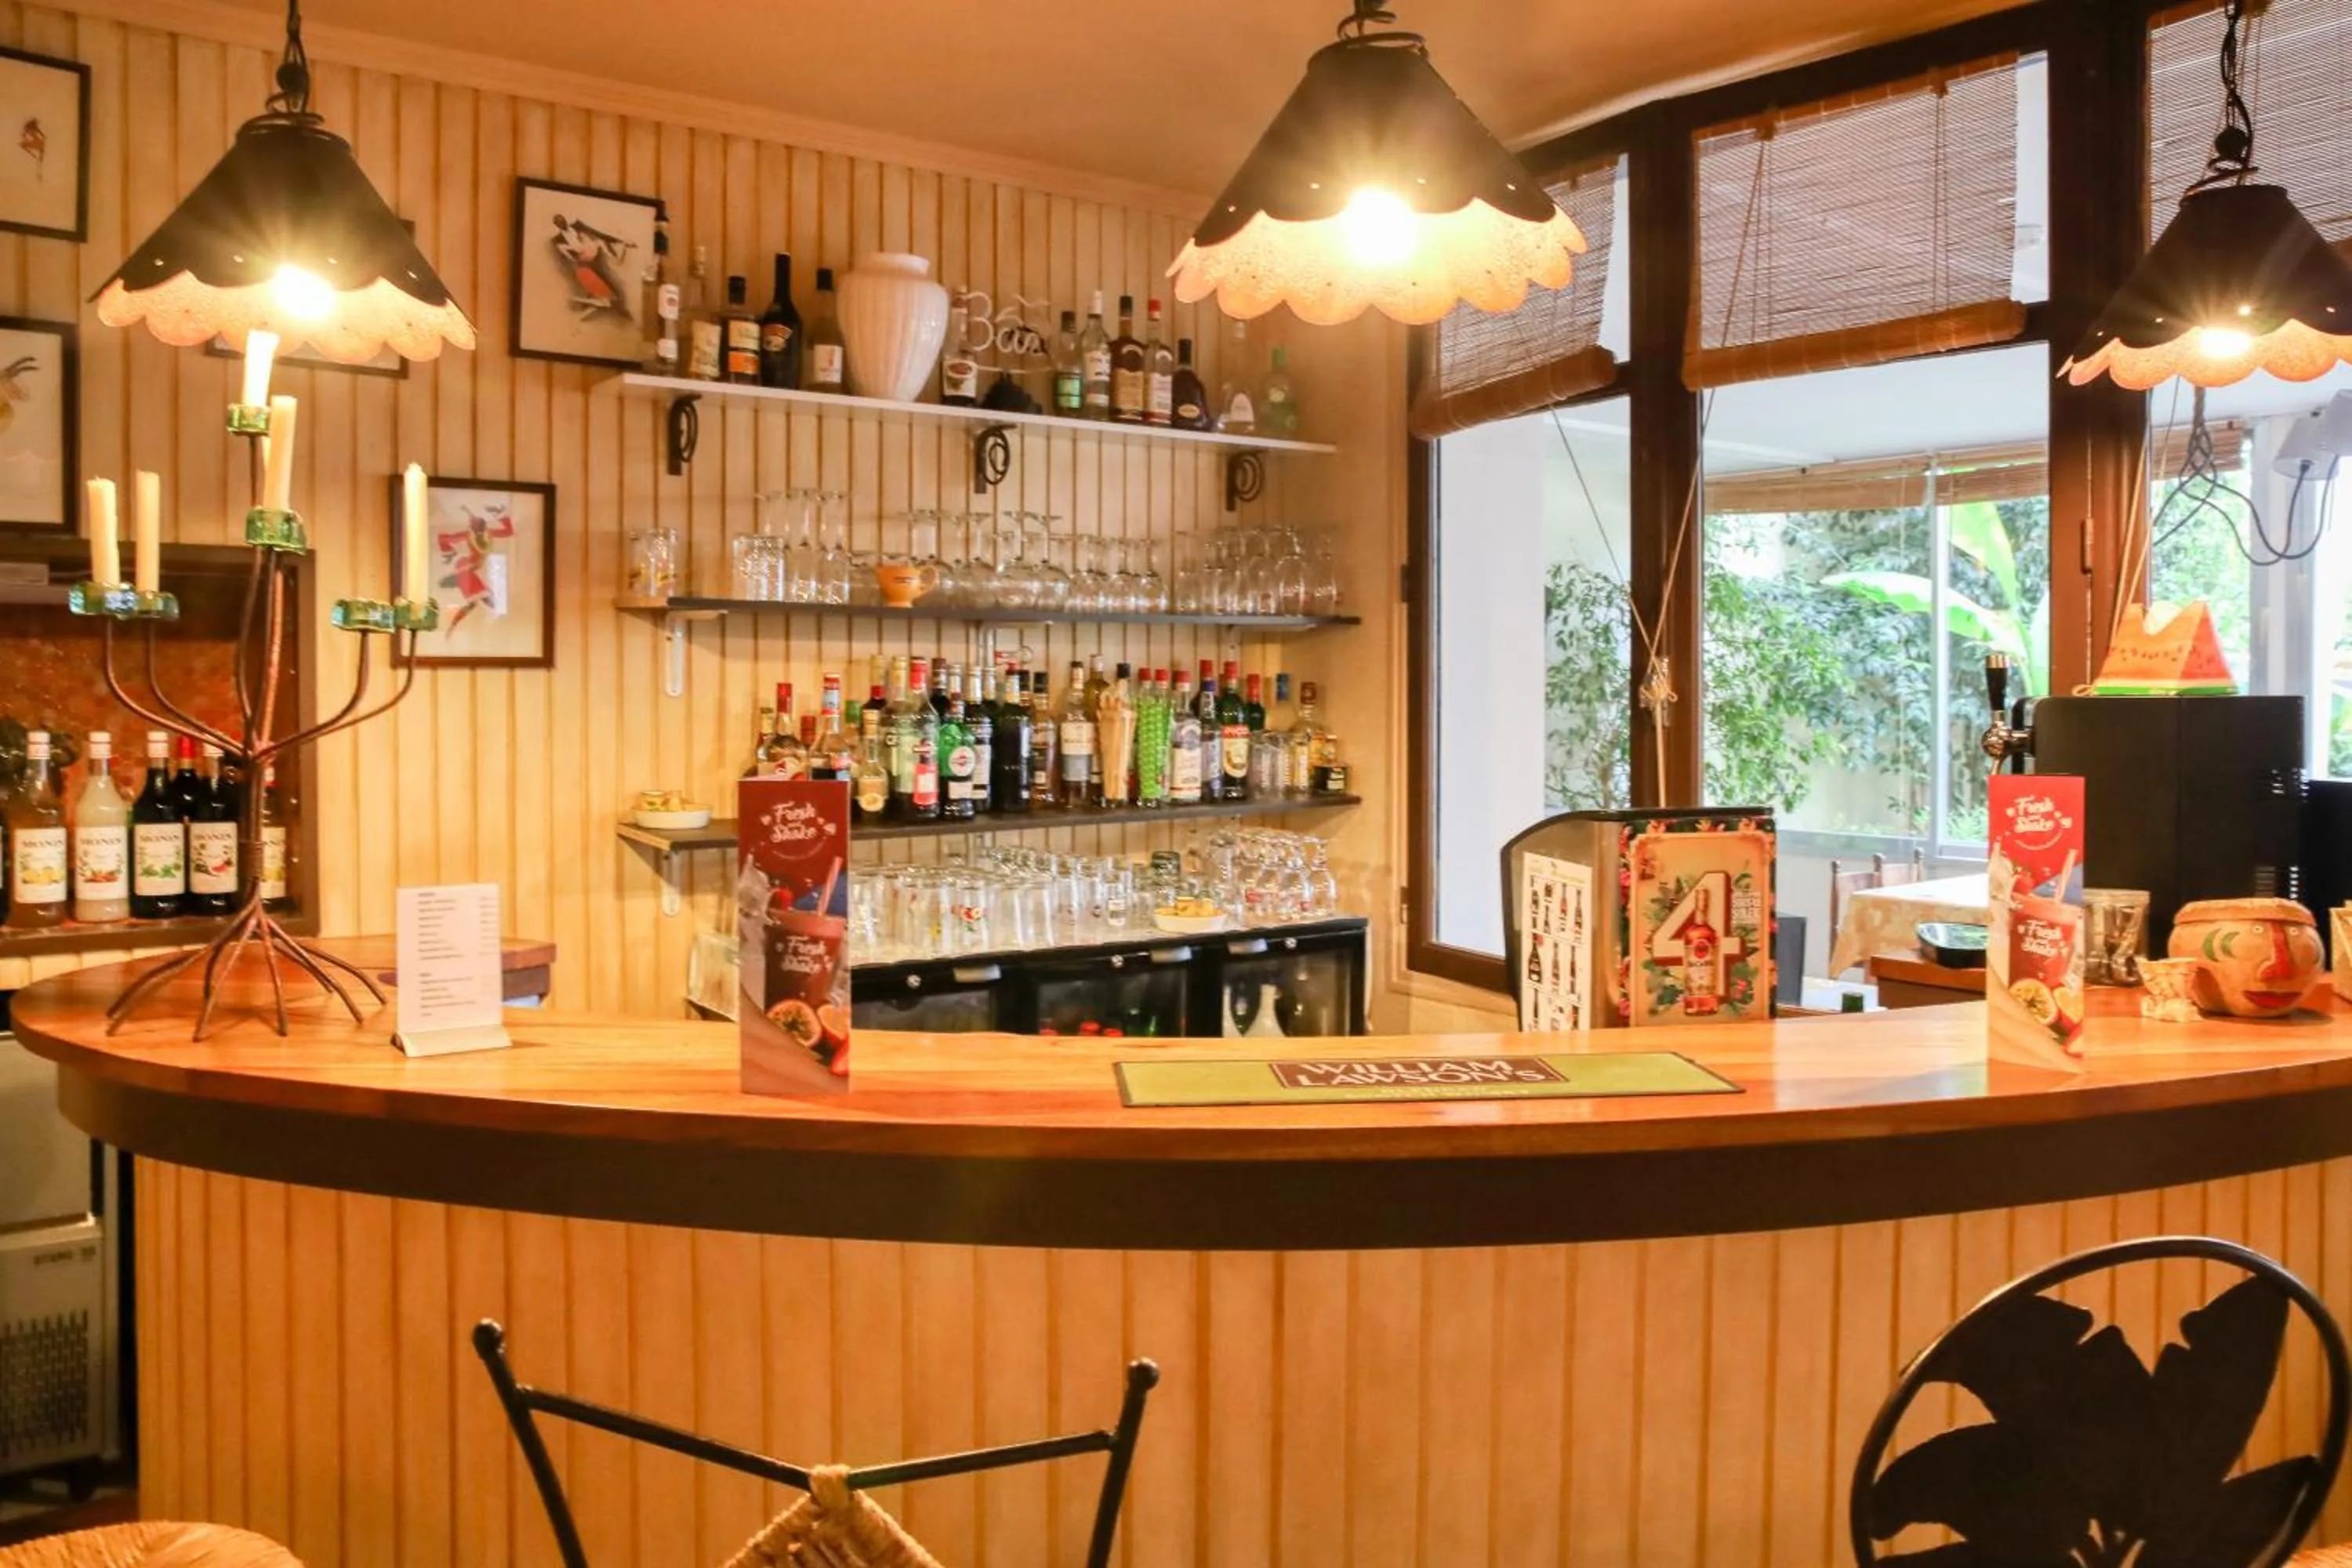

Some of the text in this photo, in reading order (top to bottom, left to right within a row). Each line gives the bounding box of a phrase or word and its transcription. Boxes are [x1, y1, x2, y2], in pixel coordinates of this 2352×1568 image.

[771, 800, 815, 823] Fresh
[769, 823, 816, 843] Shake
[1298, 1060, 1514, 1074] WILLIAM
[1295, 1069, 1547, 1086] LAWSON'S
